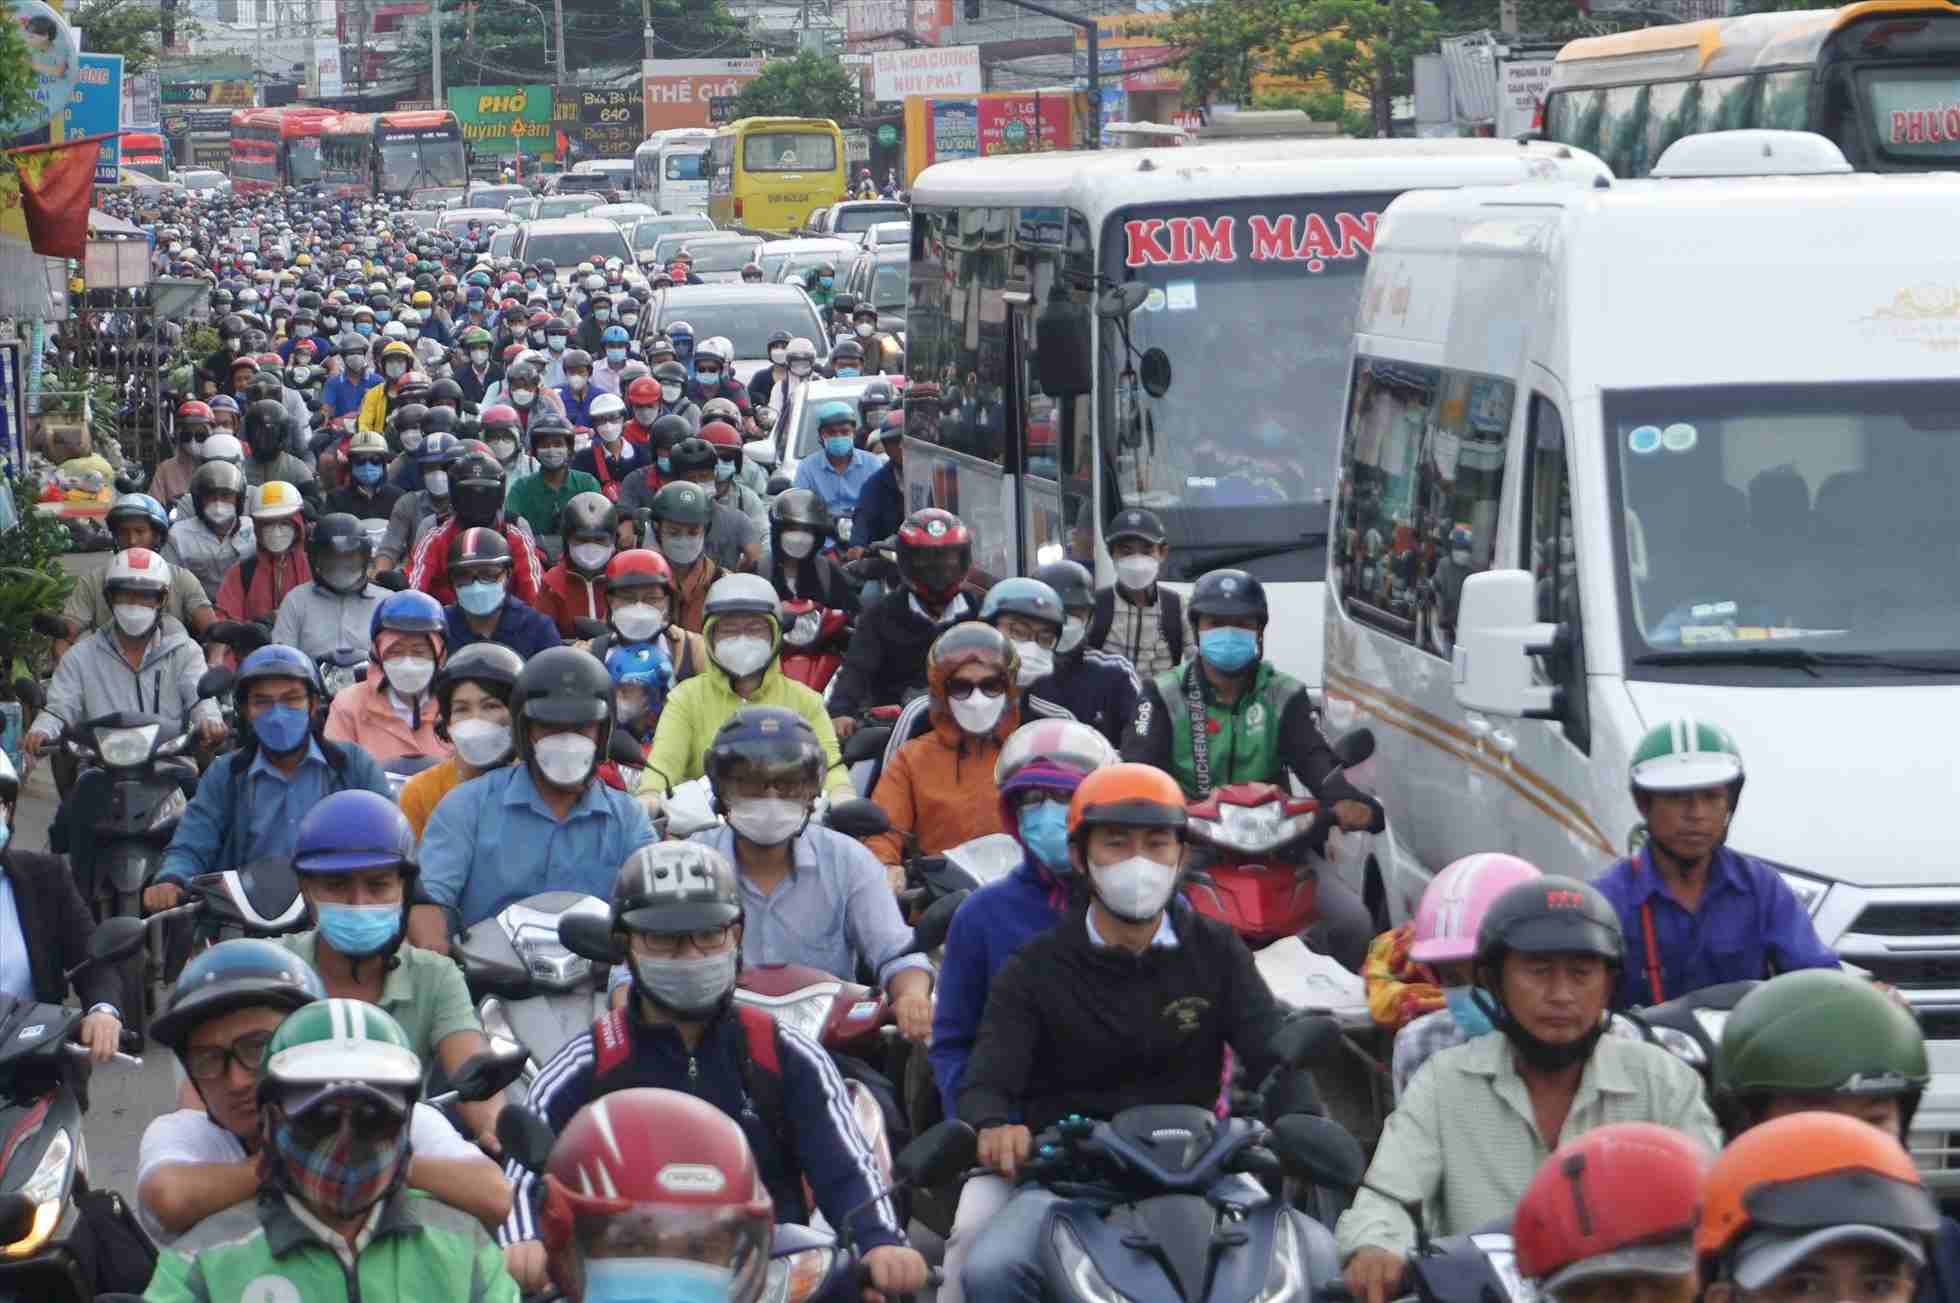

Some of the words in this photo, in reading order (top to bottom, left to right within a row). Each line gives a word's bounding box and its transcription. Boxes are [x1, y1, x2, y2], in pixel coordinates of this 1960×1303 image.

[478, 88, 529, 113] PHỞ
[648, 79, 692, 103] THẾ
[600, 108, 631, 122] 640
[1018, 102, 1036, 113] LG
[1124, 216, 1237, 267] KIM
[1248, 211, 1379, 272] MẠN
[1152, 1129, 1192, 1137] HONDA
